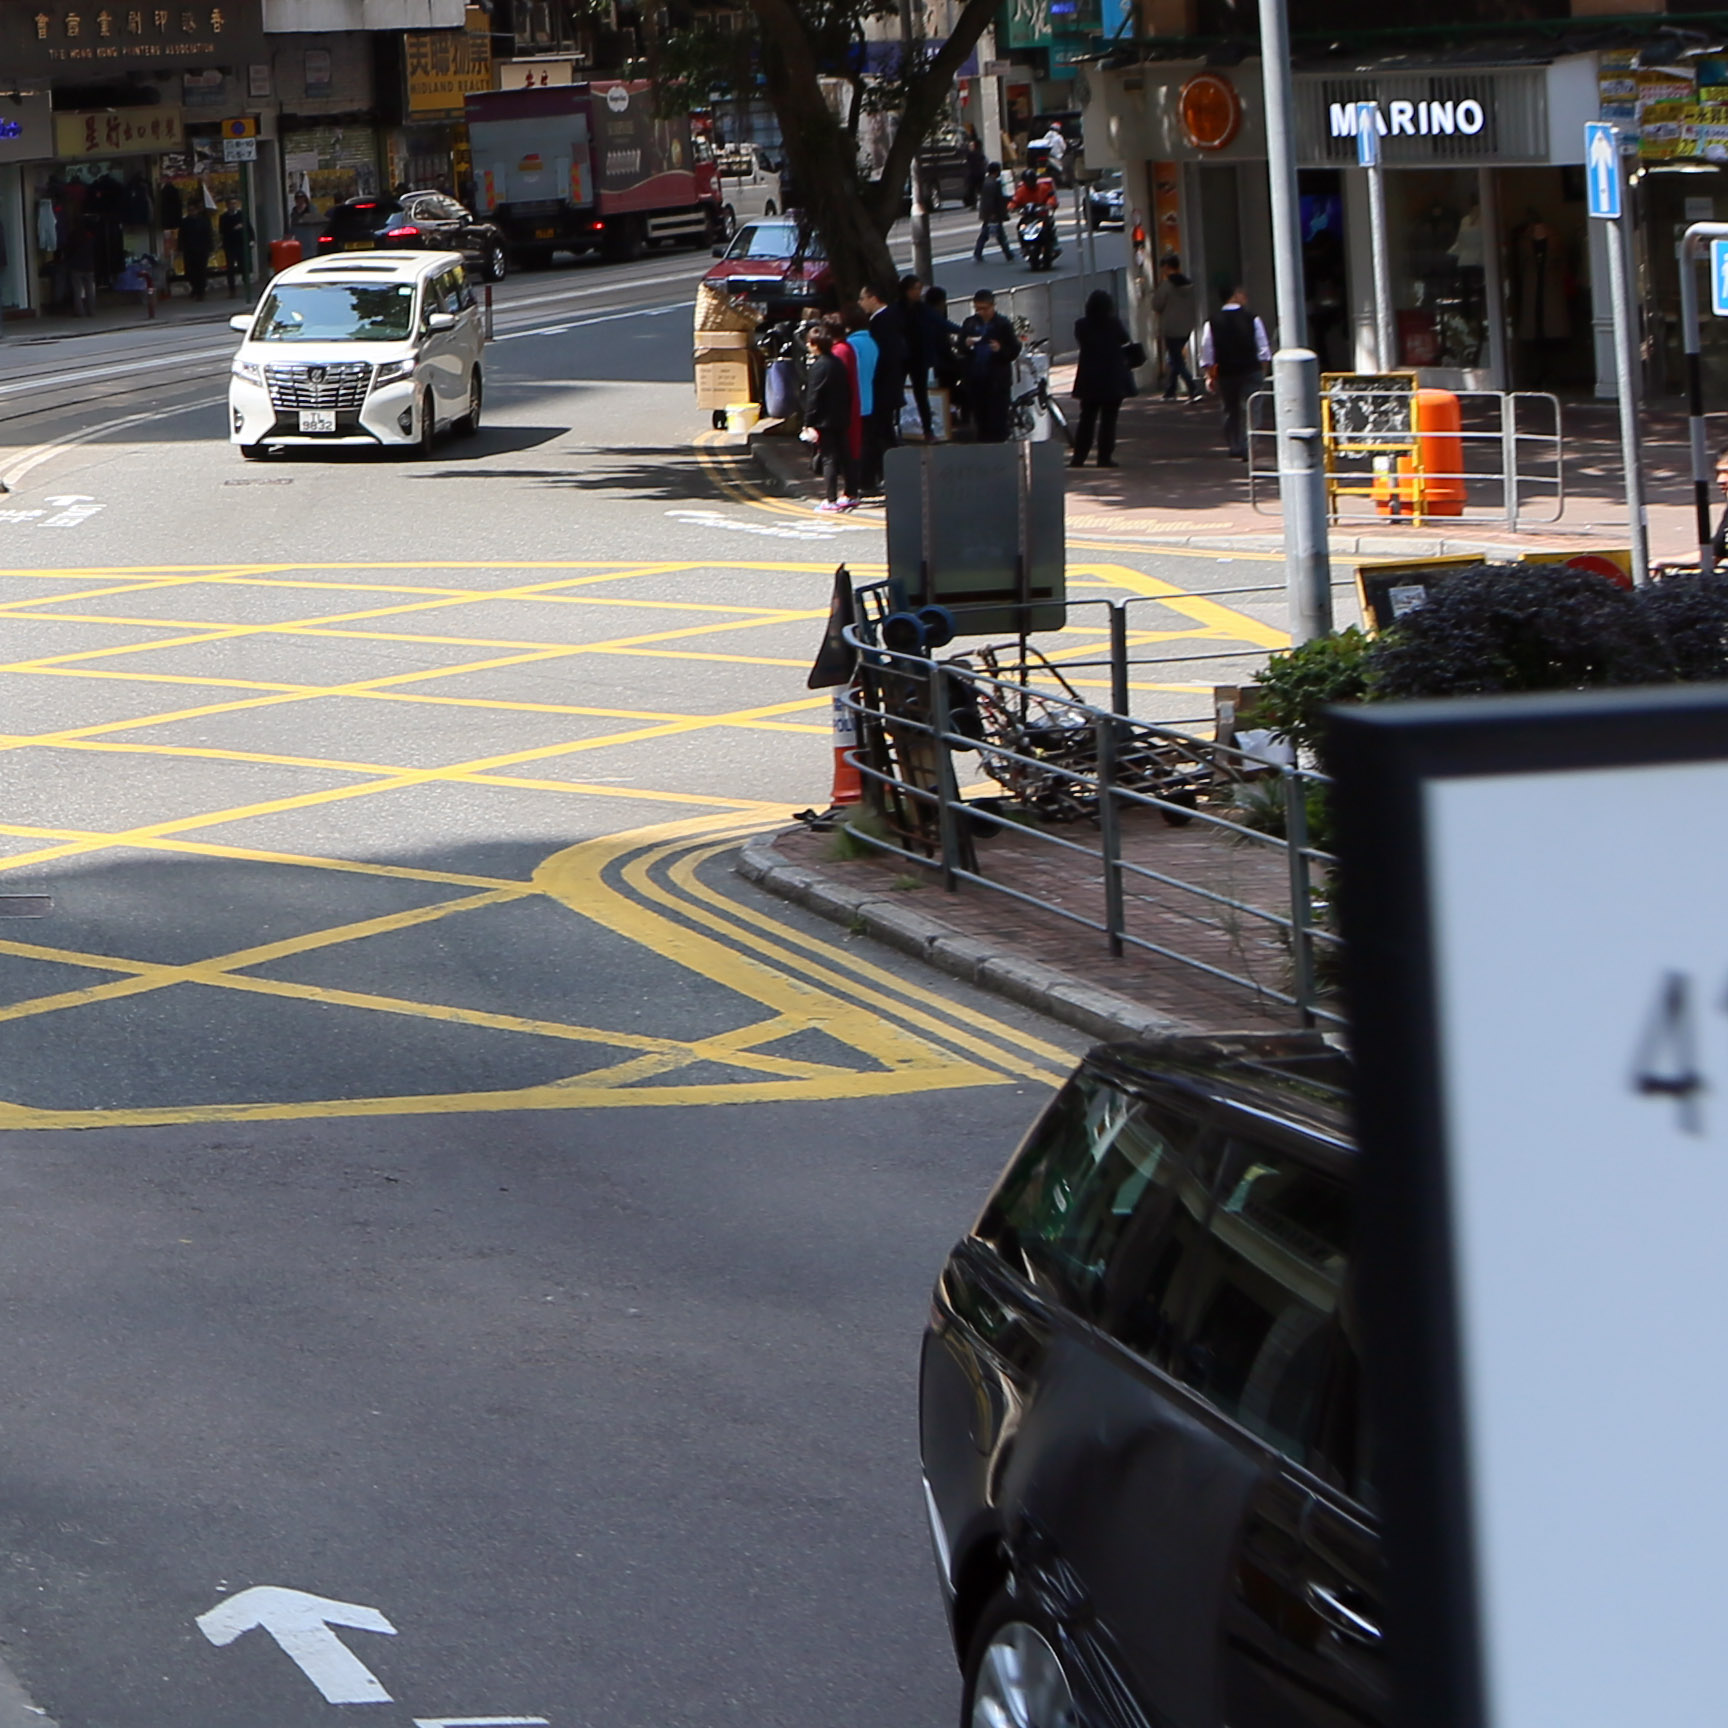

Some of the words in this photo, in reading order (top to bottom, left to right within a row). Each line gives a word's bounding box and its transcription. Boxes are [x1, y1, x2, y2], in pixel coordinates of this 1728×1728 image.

[70, 47, 92, 59] HONG
[96, 46, 117, 58] KONG
[458, 79, 489, 92] REALTY
[310, 413, 325, 423] TL
[303, 421, 332, 431] 9832
[1624, 962, 1728, 1139] 4
